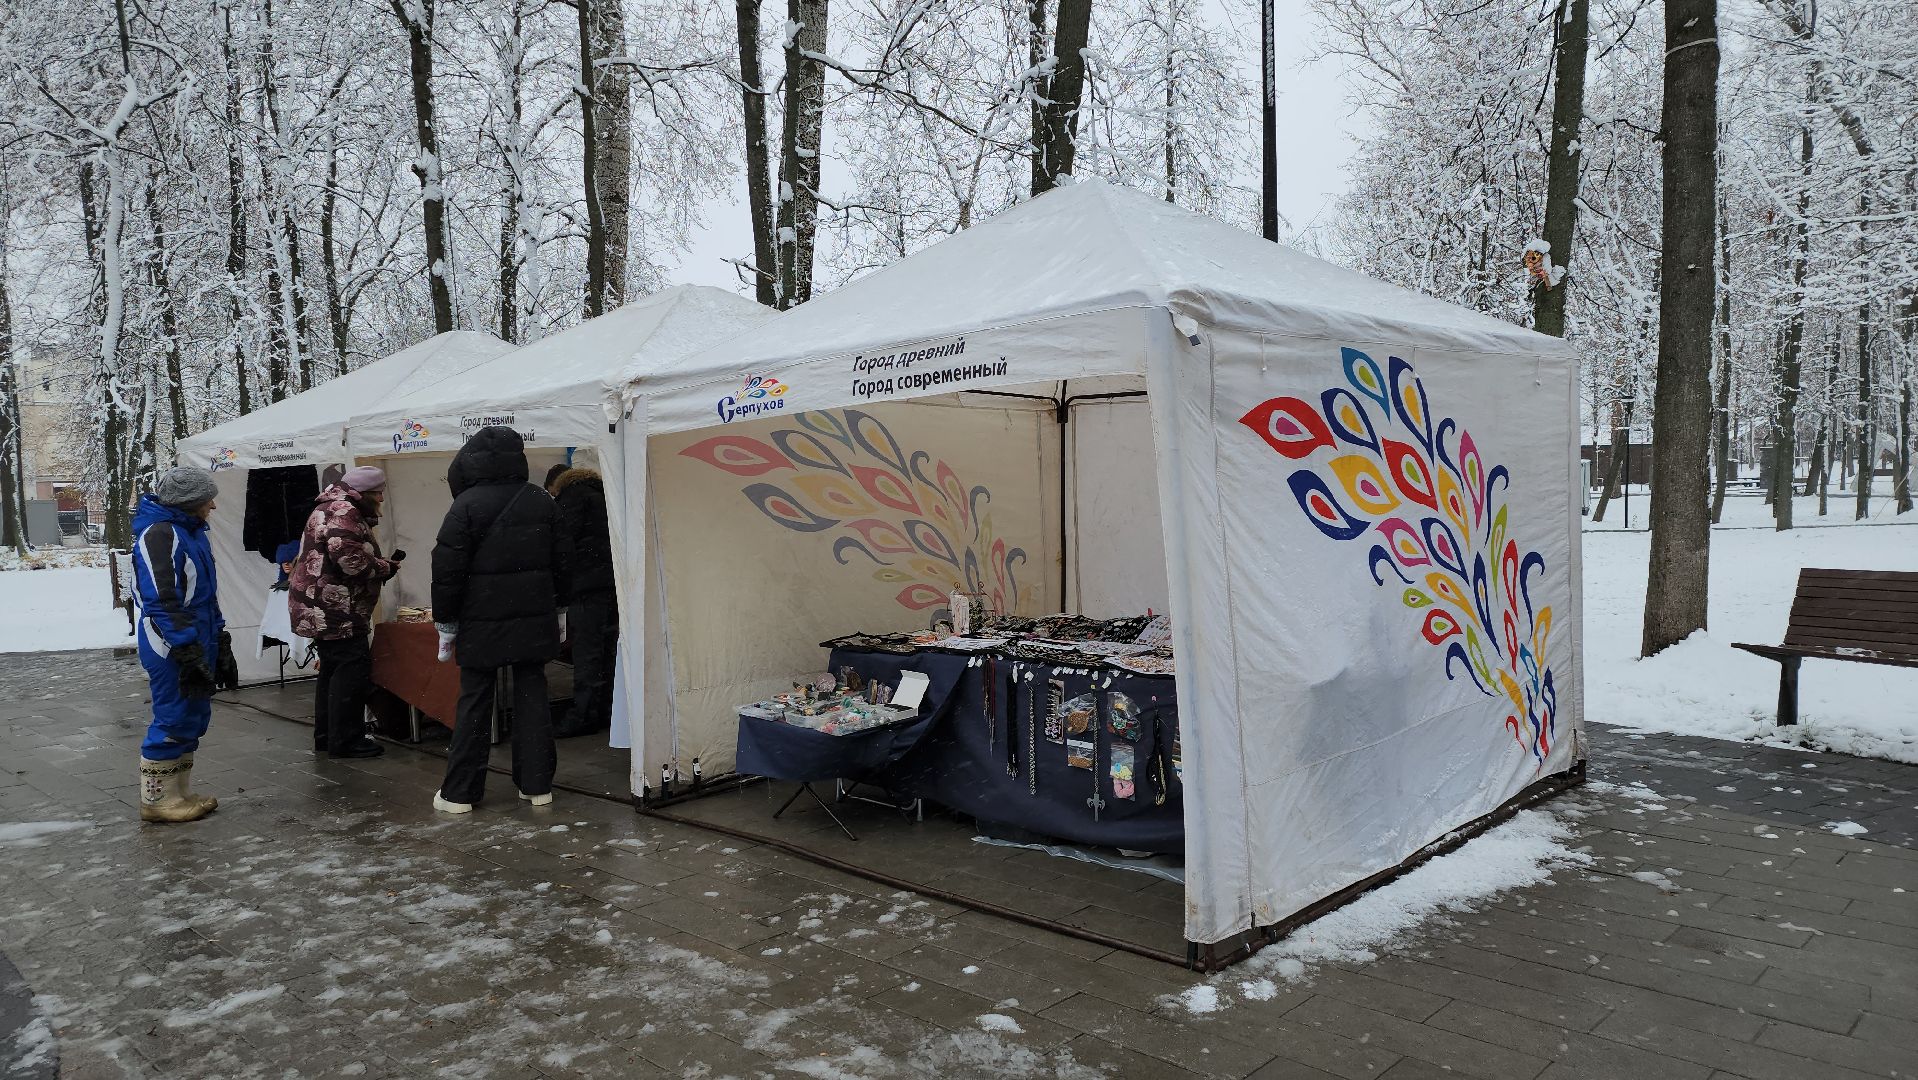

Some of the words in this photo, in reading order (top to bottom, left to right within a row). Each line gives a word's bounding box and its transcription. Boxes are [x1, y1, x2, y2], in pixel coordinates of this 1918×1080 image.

[853, 355, 895, 374] Город
[896, 337, 966, 368] древний
[852, 379, 894, 399] Город
[897, 356, 1008, 391] современный
[717, 396, 784, 424] Серпухов
